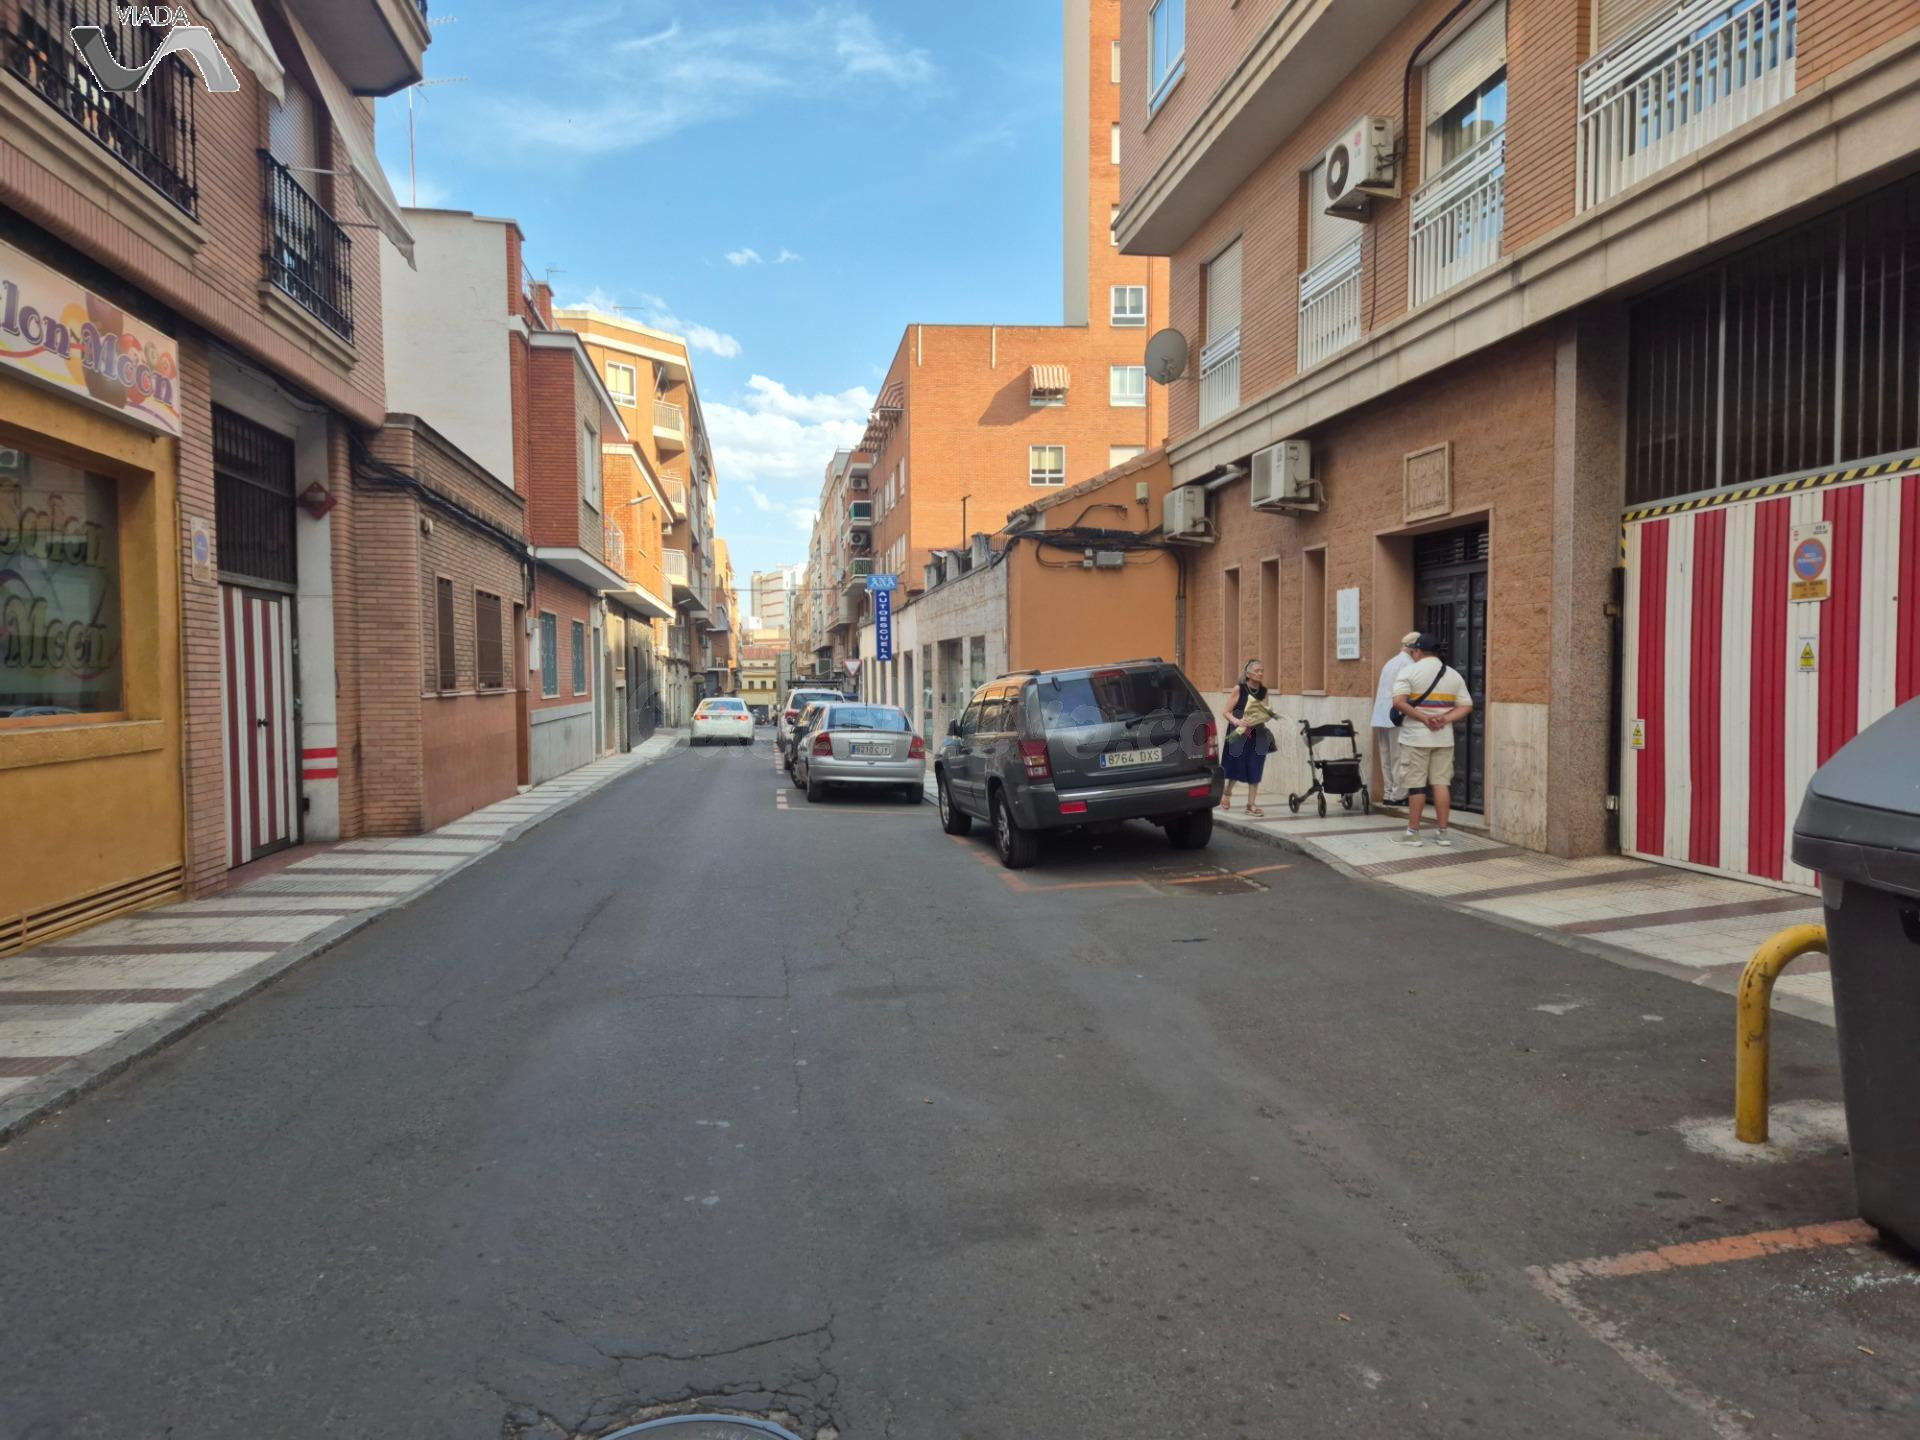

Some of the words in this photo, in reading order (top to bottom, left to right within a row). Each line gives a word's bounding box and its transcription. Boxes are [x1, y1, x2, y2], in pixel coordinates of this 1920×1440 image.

[81, 322, 173, 405] Moon
[878, 591, 888, 659] AUTOESCUELA
[1108, 753, 1134, 765] 8764
[1140, 750, 1160, 762] DXS
